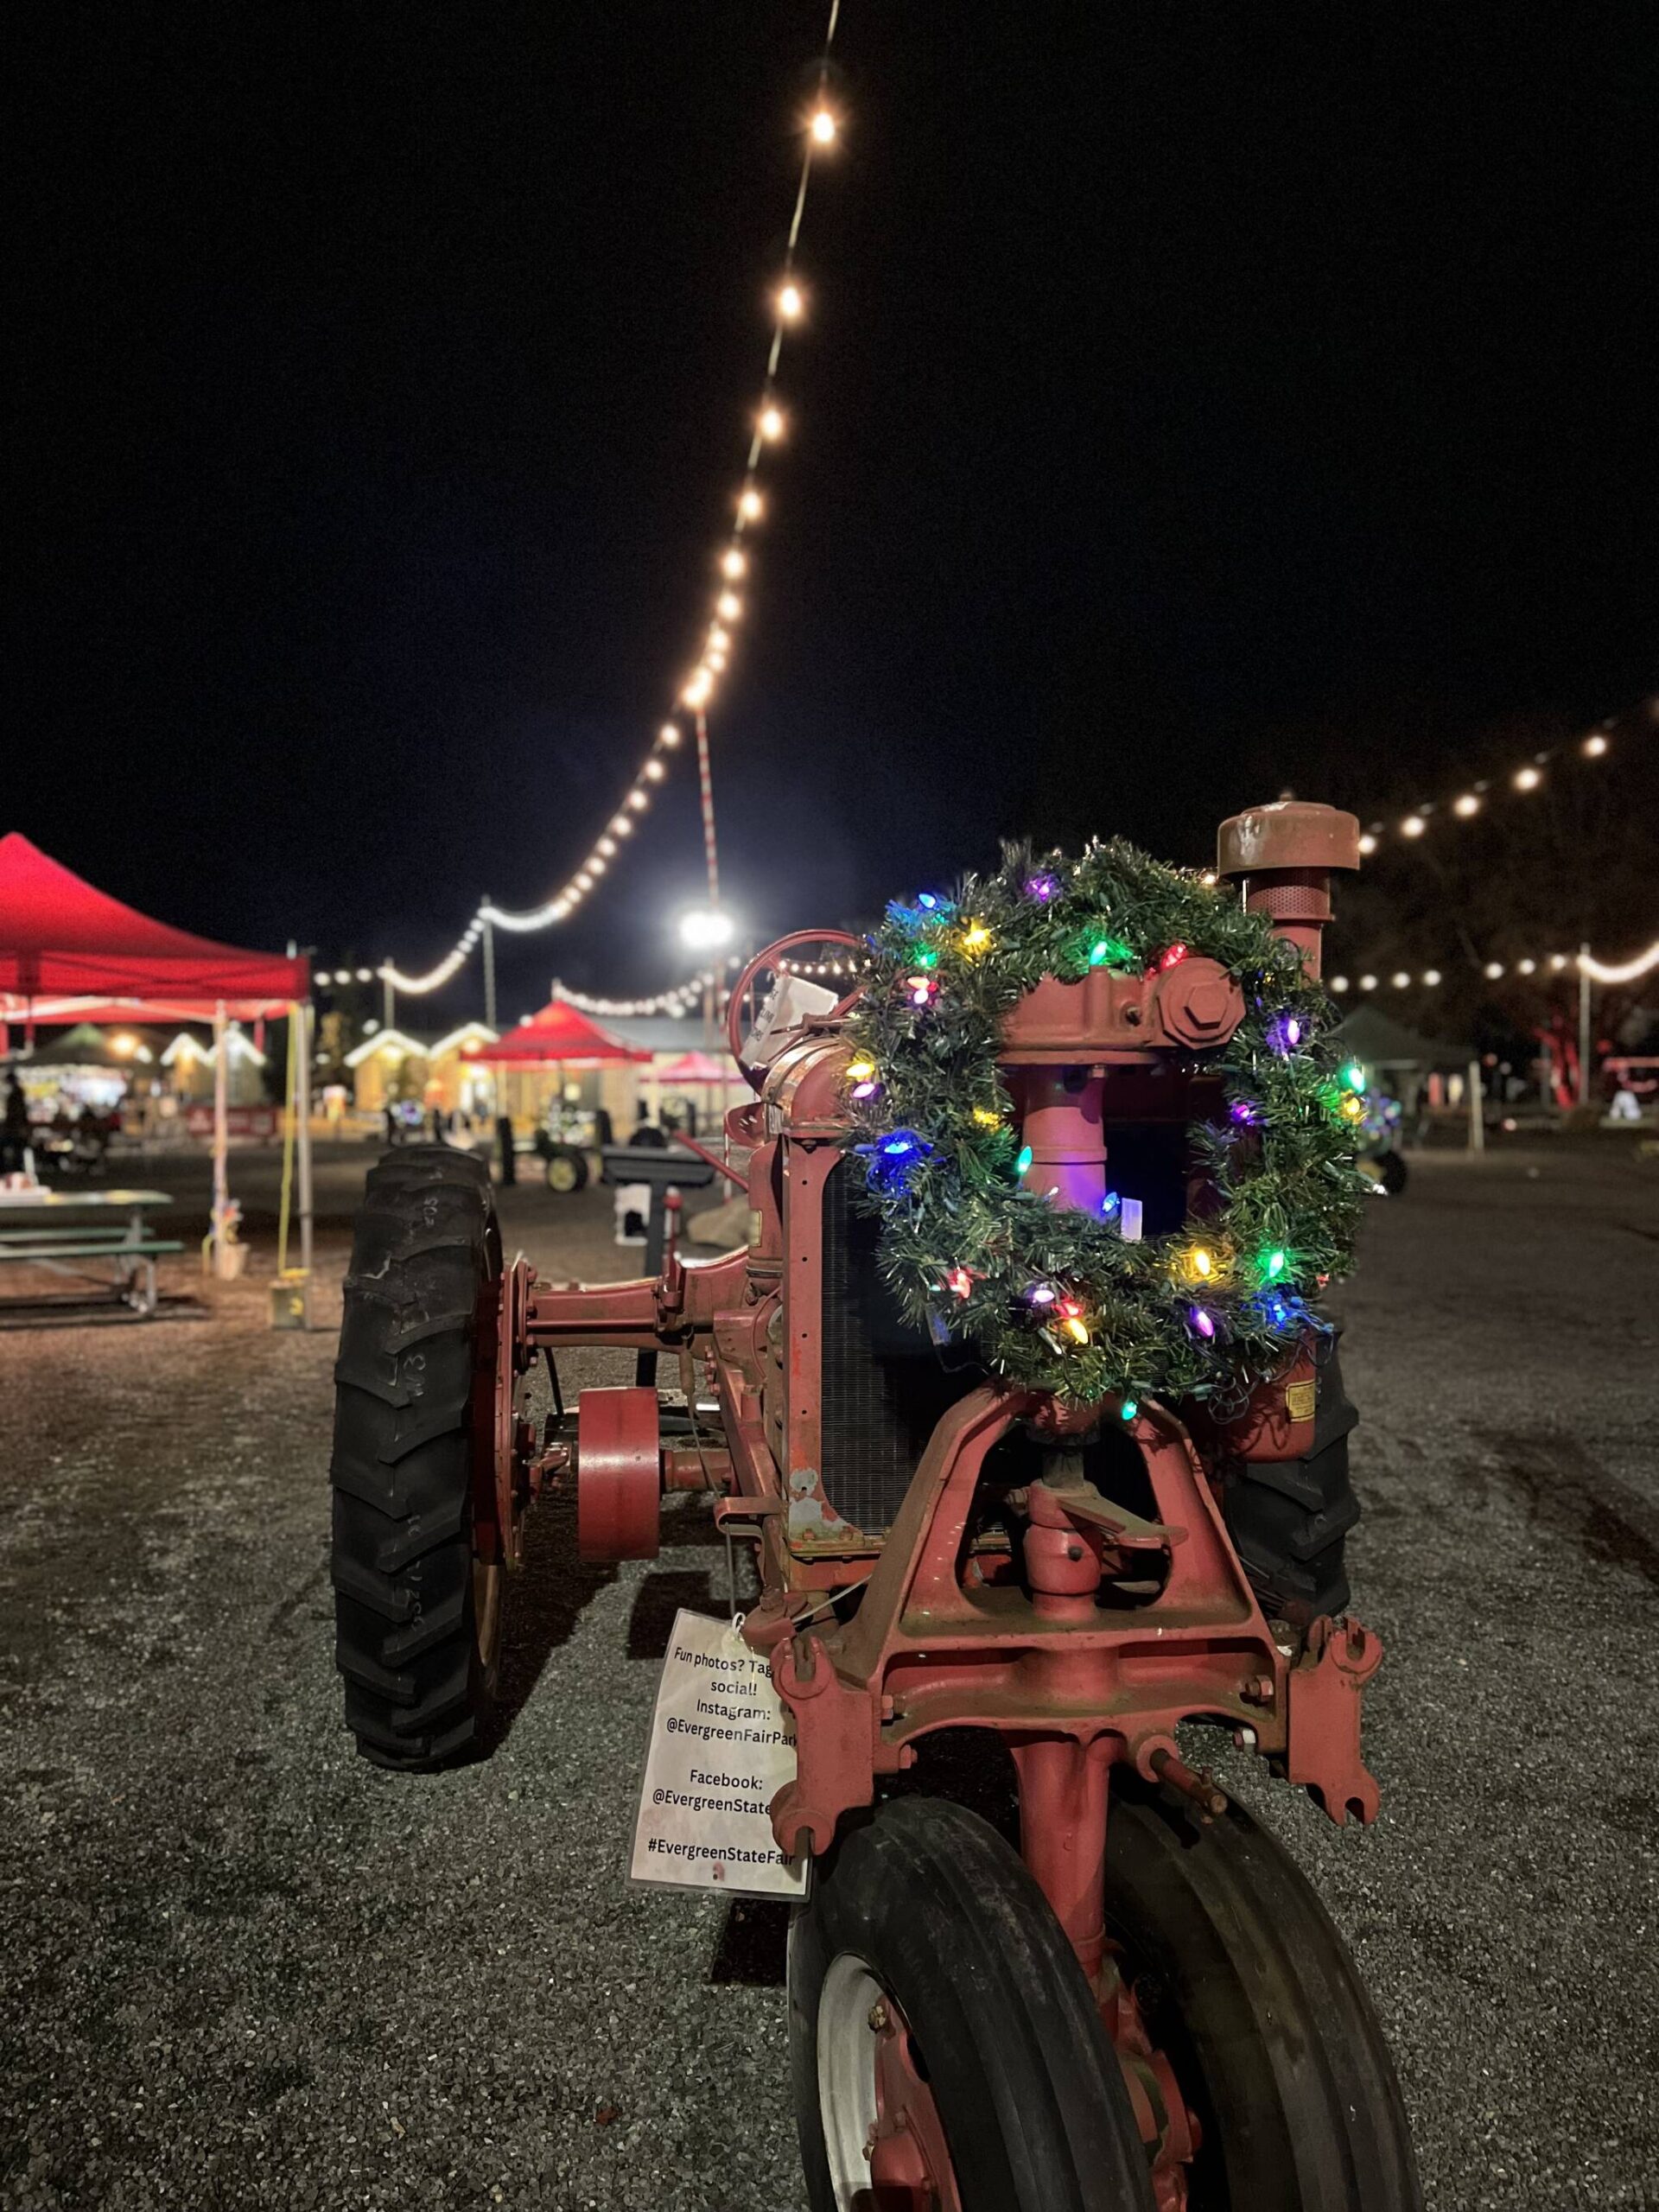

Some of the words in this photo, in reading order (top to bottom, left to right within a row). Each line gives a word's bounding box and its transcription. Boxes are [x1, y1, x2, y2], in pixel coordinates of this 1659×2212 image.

[674, 1647, 692, 1663] Fun
[694, 1653, 745, 1671] photos?
[749, 1660, 772, 1678] Tag
[711, 1681, 758, 1696] social!
[696, 1699, 771, 1720] Instagram:
[690, 1769, 762, 1790] Facebook:
[648, 1838, 795, 1866] #EvergreenStateFair
